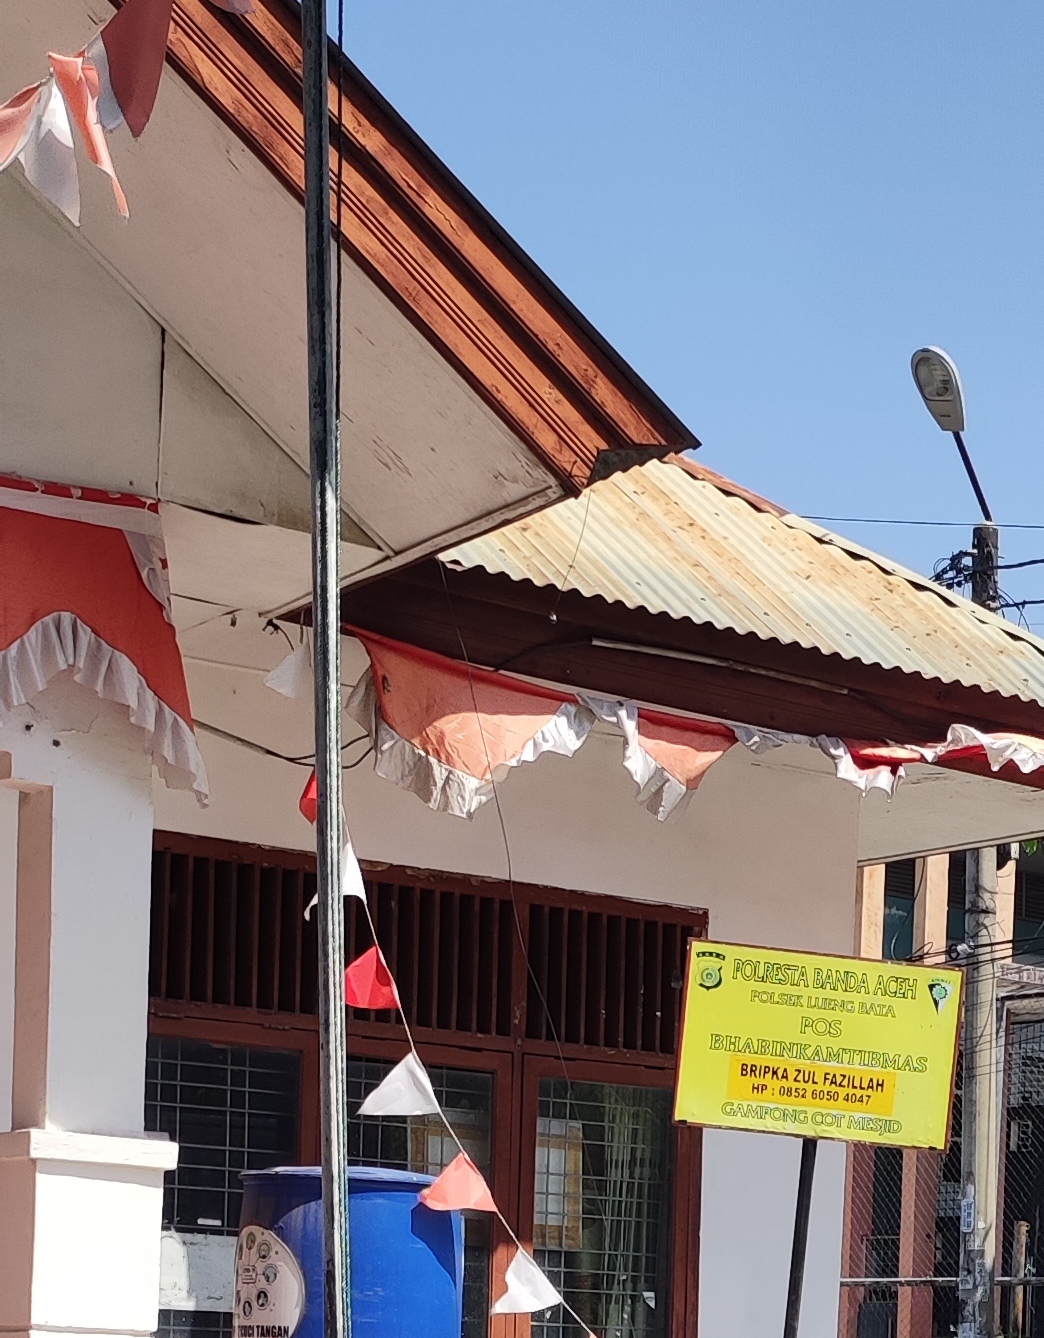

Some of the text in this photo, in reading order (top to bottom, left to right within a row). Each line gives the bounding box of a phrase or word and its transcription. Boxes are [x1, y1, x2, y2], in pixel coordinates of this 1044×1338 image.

[732, 958, 918, 1000] POLRESTA BANDA ACEH
[750, 990, 896, 1018] POLSEK LUENG BATA
[800, 1016, 842, 1038] POS
[709, 1033, 928, 1073] BHABINKAMTIBMAS
[740, 1063, 885, 1093] BRIPKA ZUL FAZILLAH
[751, 1083, 767, 1095] HP
[779, 1085, 807, 1099] 0852
[811, 1088, 839, 1102] 6050
[843, 1093, 872, 1106] 4047
[721, 1102, 903, 1136] GAMPONG COT MESJID
[256, 1324, 290, 1338] TANGAN
